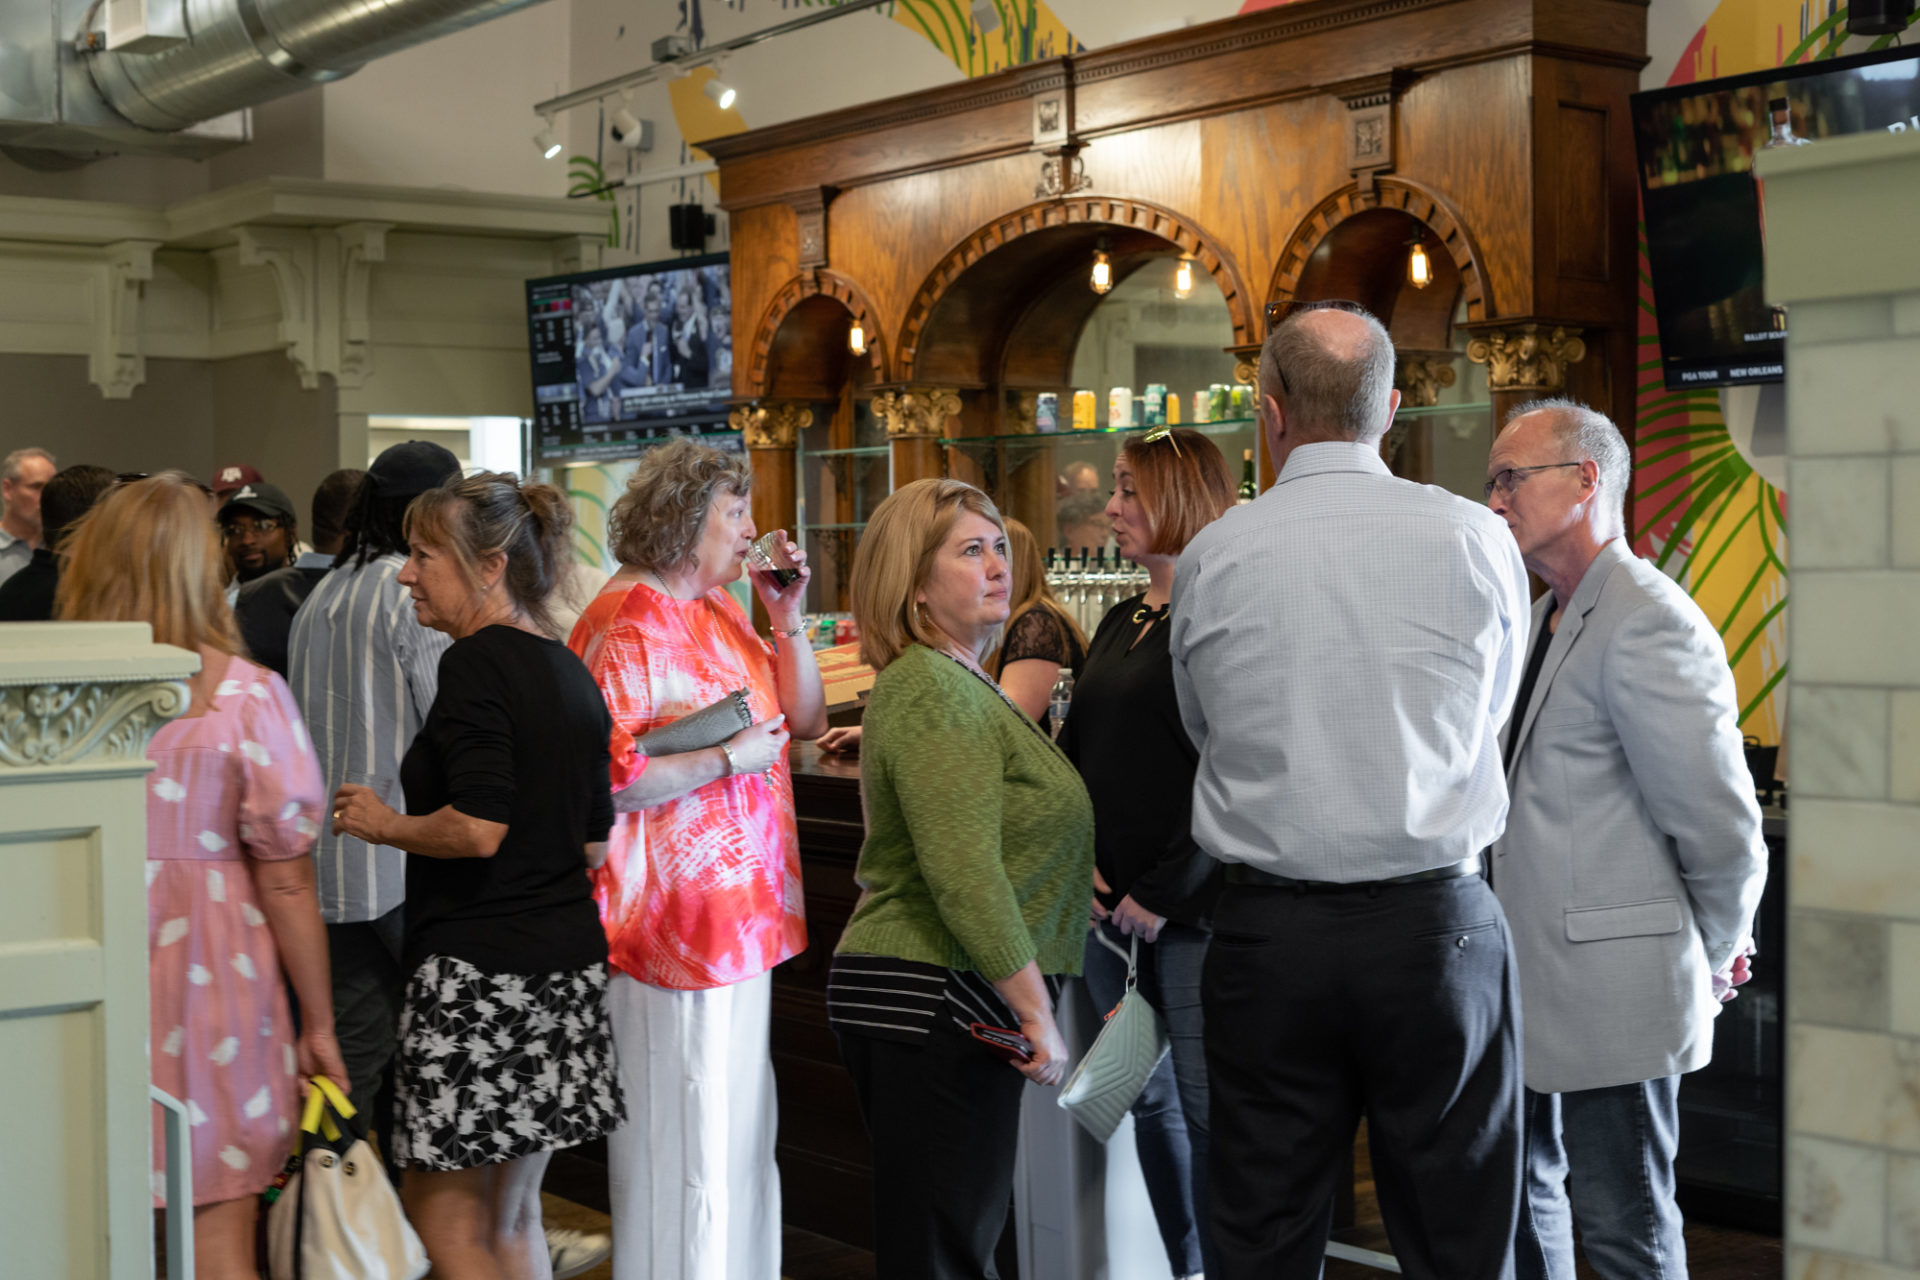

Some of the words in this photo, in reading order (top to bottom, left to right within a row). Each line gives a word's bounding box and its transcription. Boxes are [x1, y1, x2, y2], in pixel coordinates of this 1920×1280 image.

[1682, 371, 1697, 381] PGA
[1698, 370, 1718, 380] TOUR
[1730, 368, 1747, 377] NEW
[1748, 365, 1783, 376] ORLEANS
